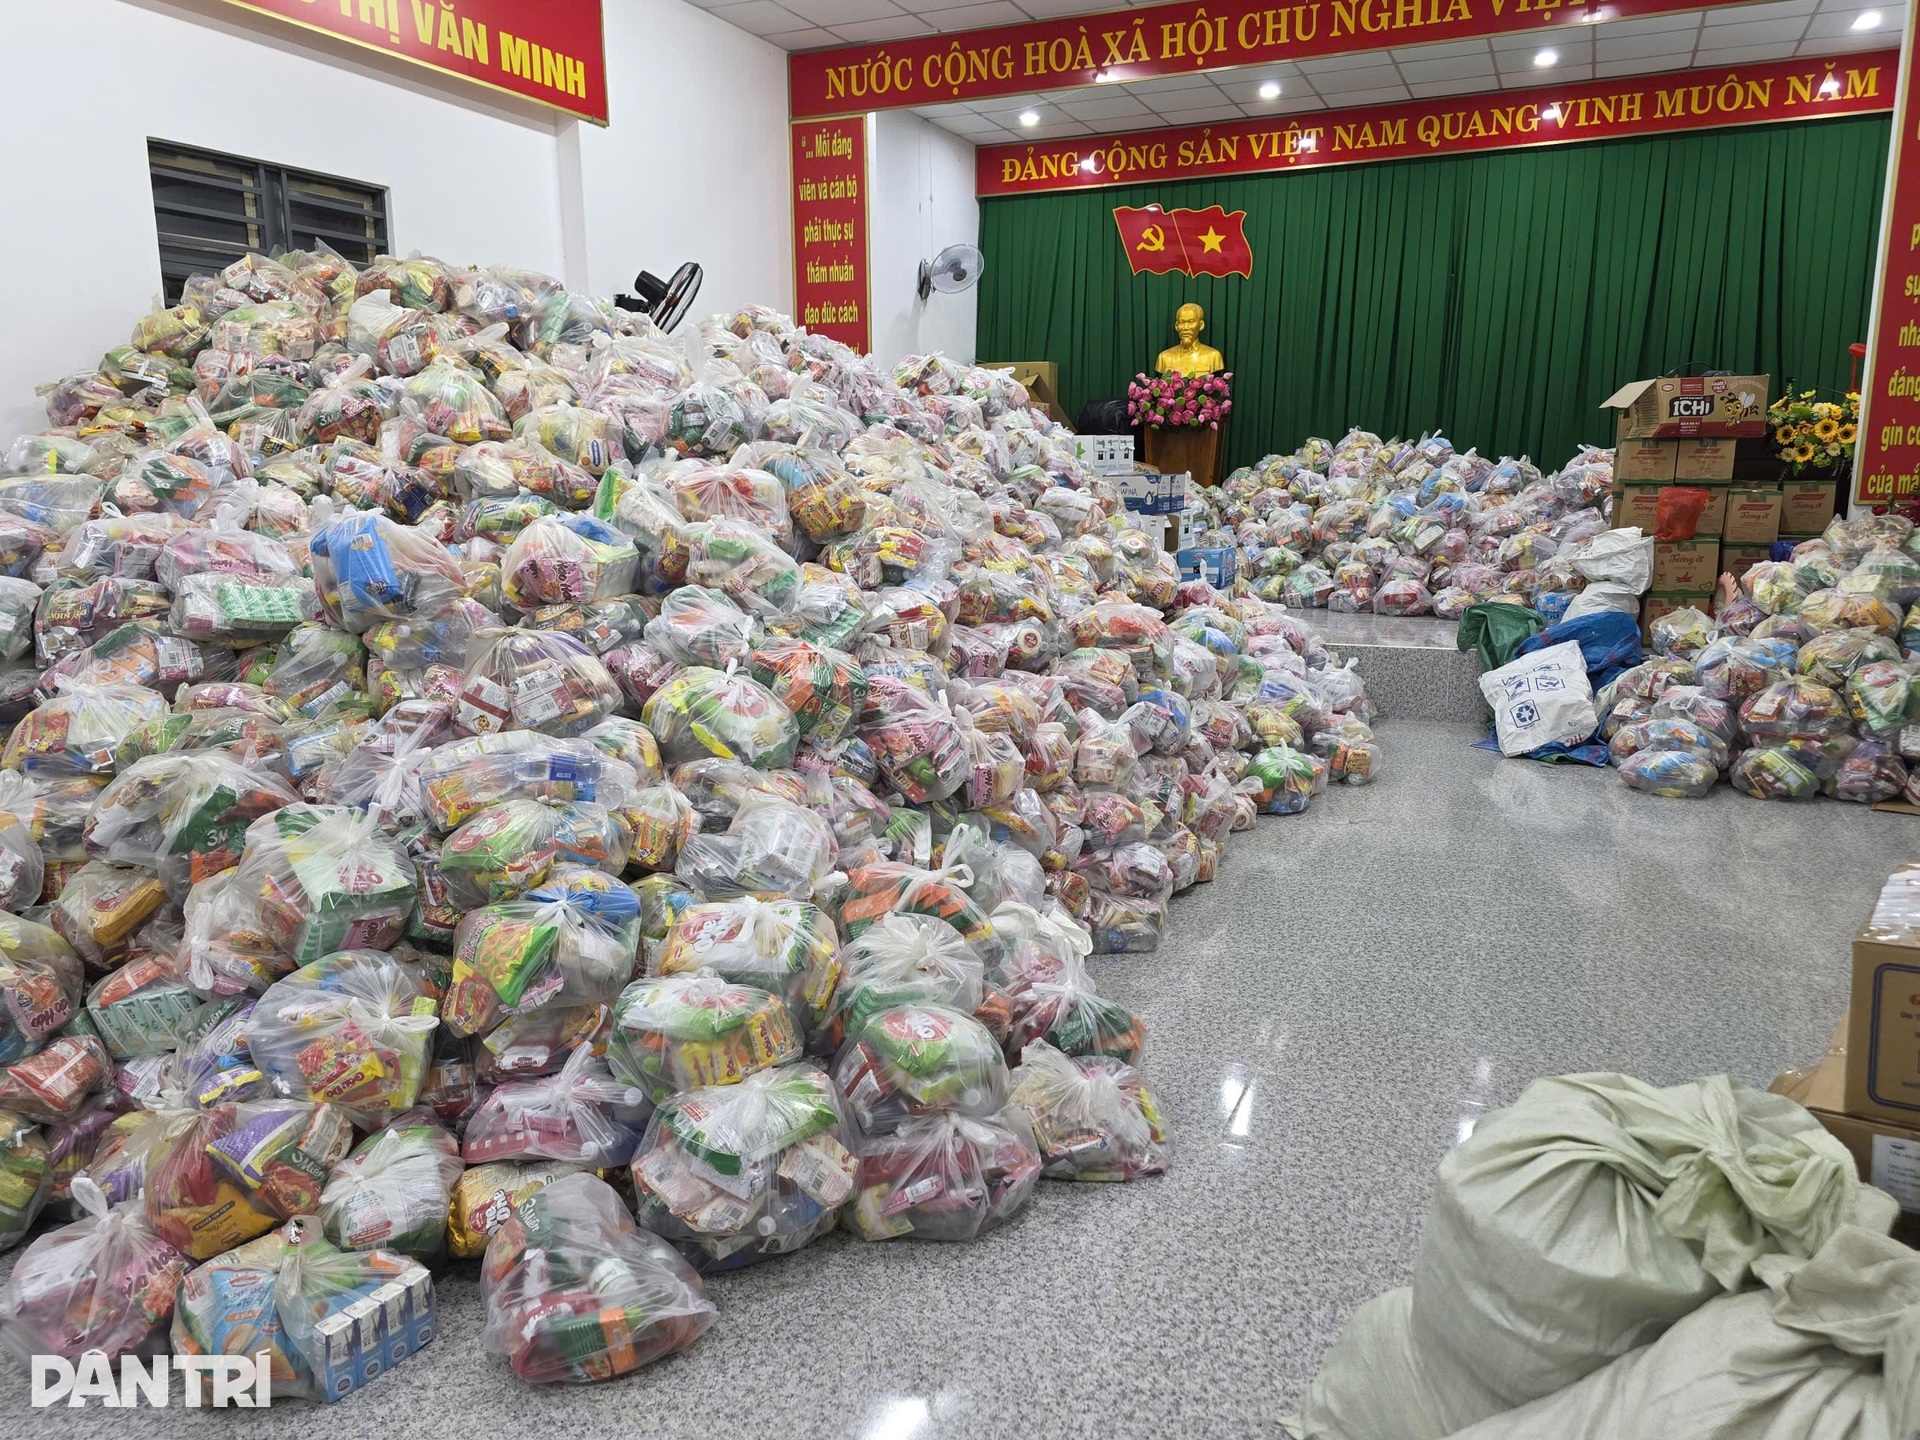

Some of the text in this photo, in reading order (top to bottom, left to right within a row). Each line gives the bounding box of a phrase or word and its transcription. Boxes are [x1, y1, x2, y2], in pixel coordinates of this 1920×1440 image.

[410, 0, 489, 66] VĂN
[499, 31, 586, 99] MINH
[826, 51, 912, 99] NƯỚC
[923, 41, 1015, 95] CỘNG
[1025, 26, 1094, 76] HOÀ
[1102, 18, 1151, 67] XÃ
[1161, 8, 1228, 65] HỘI
[1002, 61, 1881, 184] ĐẢNG CỘNG SẢN VIỆT NAM QUANG VINH MUÔN NĂM
[831, 129, 853, 160] đảng
[818, 174, 828, 200] và
[829, 174, 845, 199] cán
[847, 174, 857, 204] bộ
[804, 216, 854, 248] phải thực sự
[807, 254, 854, 284] thấm nhuần
[805, 299, 858, 330] đạo đức cách
[1880, 418, 1904, 452] gìn
[1120, 488, 1138, 497] AFINA
[1669, 554, 1695, 565] Tương
